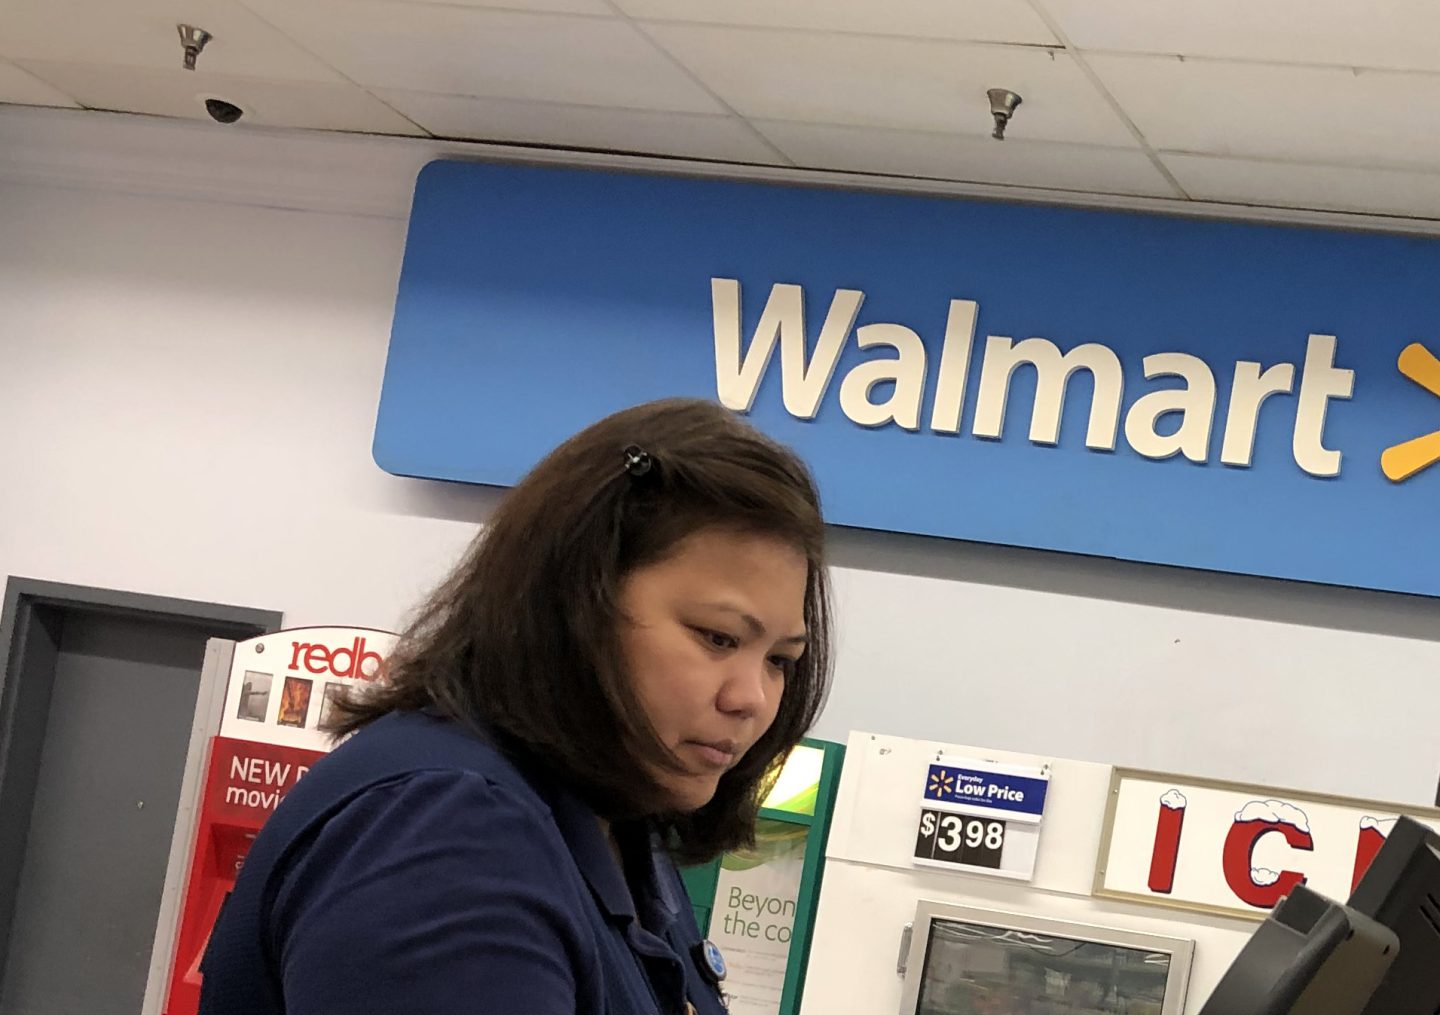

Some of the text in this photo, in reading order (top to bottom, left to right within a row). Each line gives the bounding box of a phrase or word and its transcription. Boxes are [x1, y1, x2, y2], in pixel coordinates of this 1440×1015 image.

[711, 277, 1355, 477] Walmart
[288, 636, 391, 683] redb
[230, 755, 292, 787] NEW
[957, 774, 984, 784] Everyday
[226, 786, 286, 811] movi
[955, 780, 985, 796] Low
[988, 784, 1025, 802] Price
[724, 911, 760, 938] the
